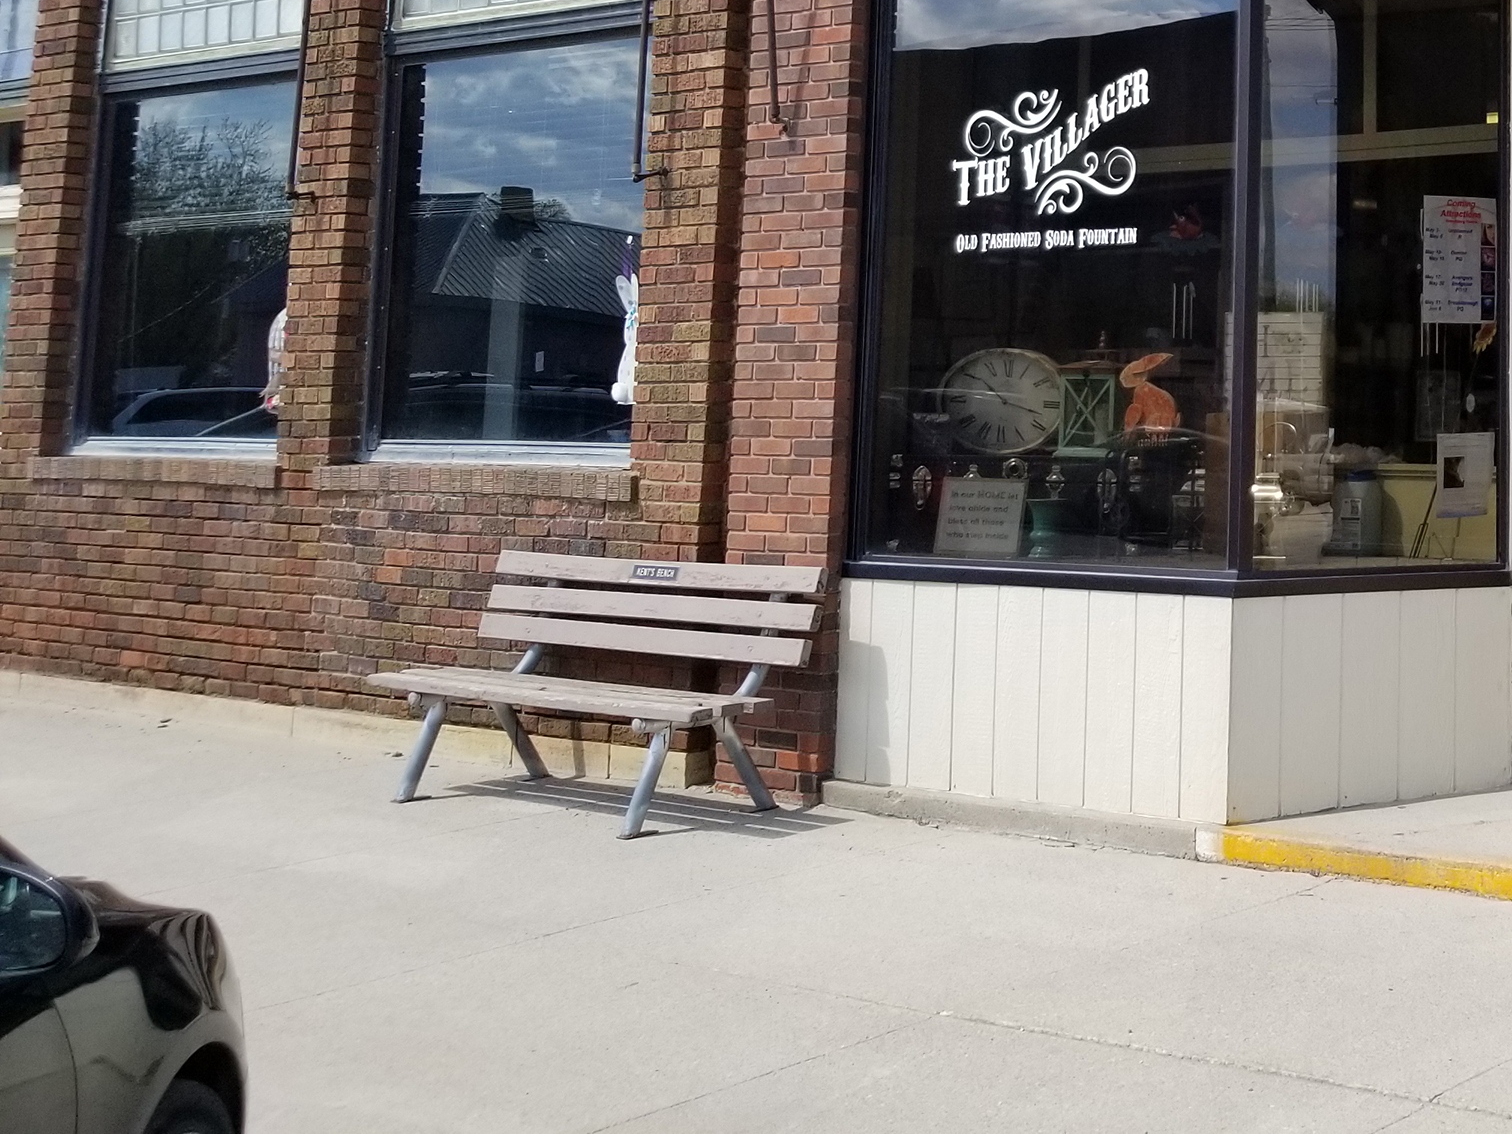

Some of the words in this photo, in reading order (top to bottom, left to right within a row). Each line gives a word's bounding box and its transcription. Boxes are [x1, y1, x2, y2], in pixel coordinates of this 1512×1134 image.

[952, 154, 1011, 206] THE
[1020, 68, 1150, 191] VILLAGER
[1447, 199, 1476, 210] Coming
[956, 233, 978, 254] OLD
[981, 230, 1041, 252] FASHIONED
[1045, 229, 1075, 250] SODA
[1078, 227, 1138, 248] FOUNTAIN
[656, 568, 675, 578] BENCH
